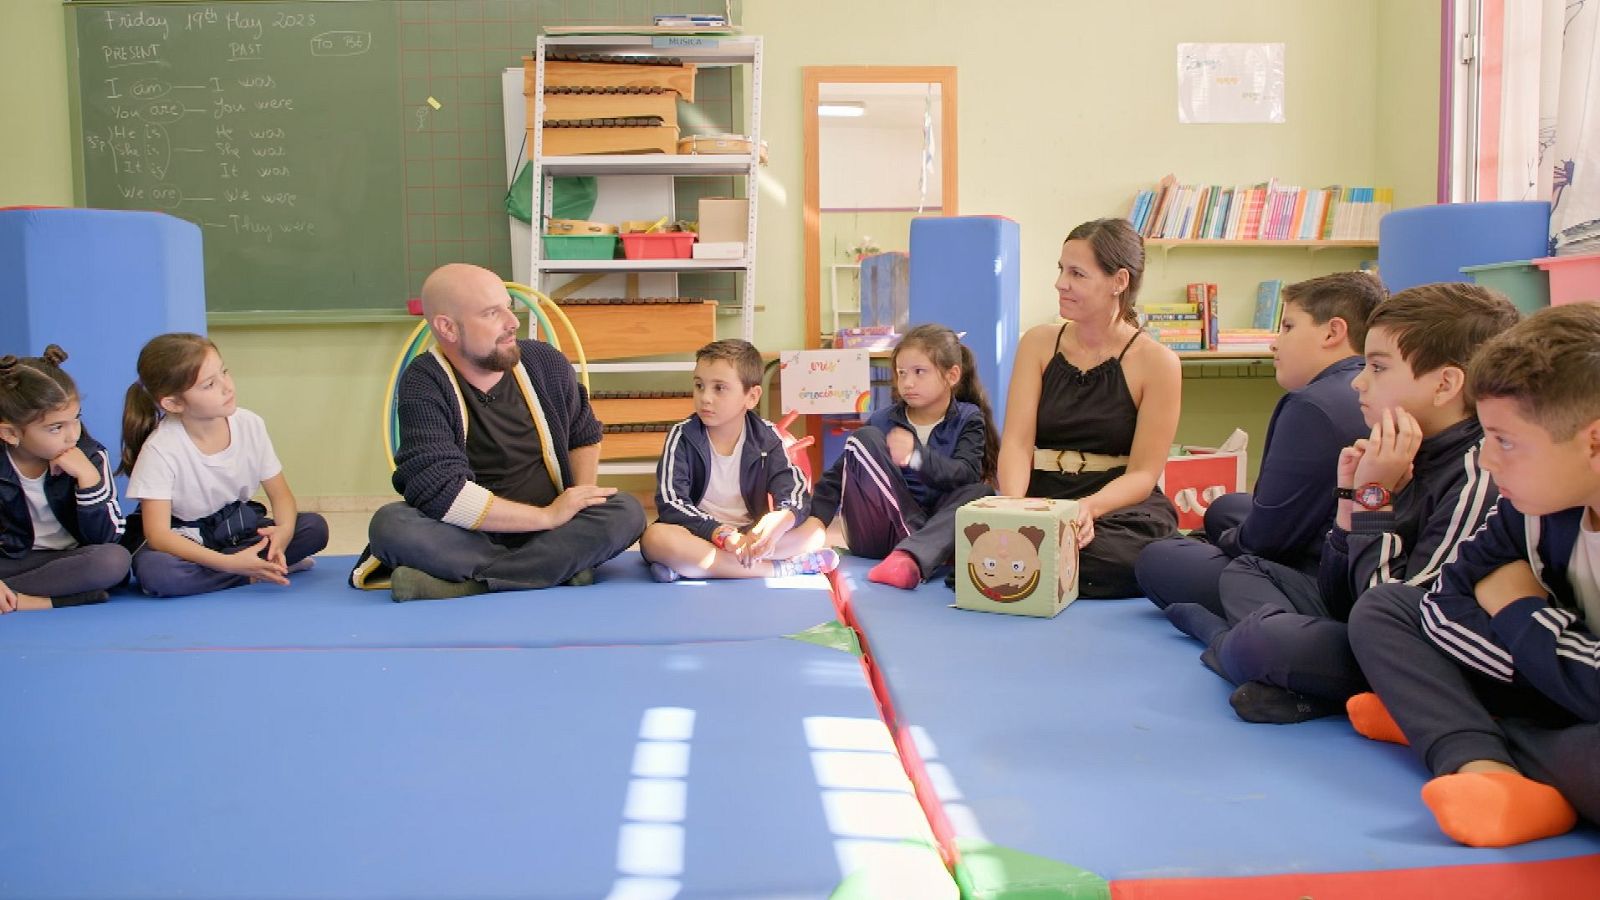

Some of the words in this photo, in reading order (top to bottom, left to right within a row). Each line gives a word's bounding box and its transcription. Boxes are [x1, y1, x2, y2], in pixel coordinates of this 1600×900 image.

[104, 10, 169, 40] Friday
[272, 12, 317, 28] 2023
[102, 43, 160, 63] PRESENT
[229, 42, 263, 57] PAST
[104, 77, 123, 99] I
[132, 82, 163, 96] am
[209, 77, 224, 92] I
[238, 74, 276, 89] was
[111, 105, 140, 119] You
[150, 103, 179, 116] are
[256, 98, 294, 111] were
[114, 125, 136, 139] He
[145, 124, 161, 139] is
[216, 124, 234, 140] He
[249, 127, 285, 139] was
[115, 141, 140, 156] She
[215, 142, 241, 158] She
[251, 146, 286, 157] was
[124, 160, 144, 173] It
[220, 162, 240, 178] It
[257, 166, 290, 177] was
[117, 183, 145, 199] We
[152, 188, 177, 200] are
[224, 185, 252, 202] We
[261, 192, 297, 207] were
